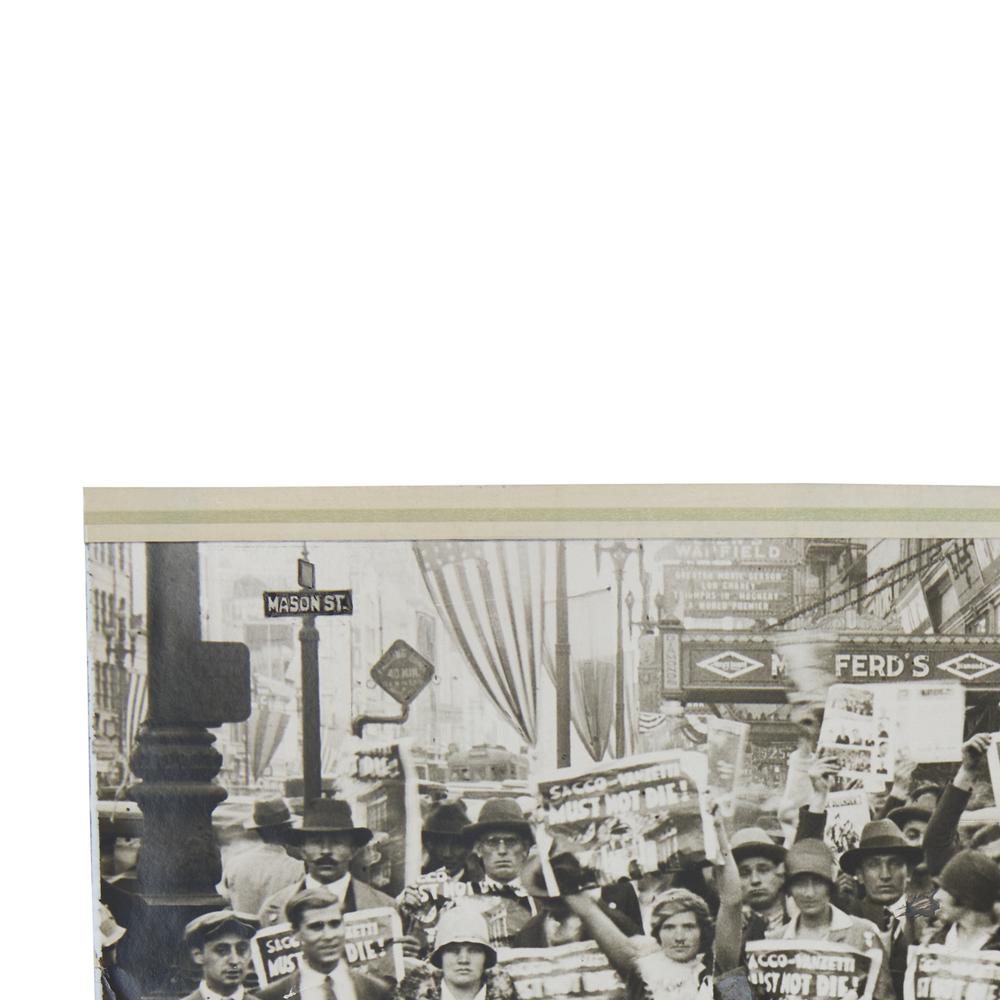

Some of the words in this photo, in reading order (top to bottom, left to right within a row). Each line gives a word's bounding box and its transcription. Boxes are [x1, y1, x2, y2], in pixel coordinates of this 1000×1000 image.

[267, 595, 321, 613] MASON
[548, 797, 601, 825] MUST
[605, 789, 641, 815] NOT
[346, 938, 387, 964] DIE!
[747, 953, 855, 972] ACCO-VANZETTI
[781, 972, 812, 996] NOT
